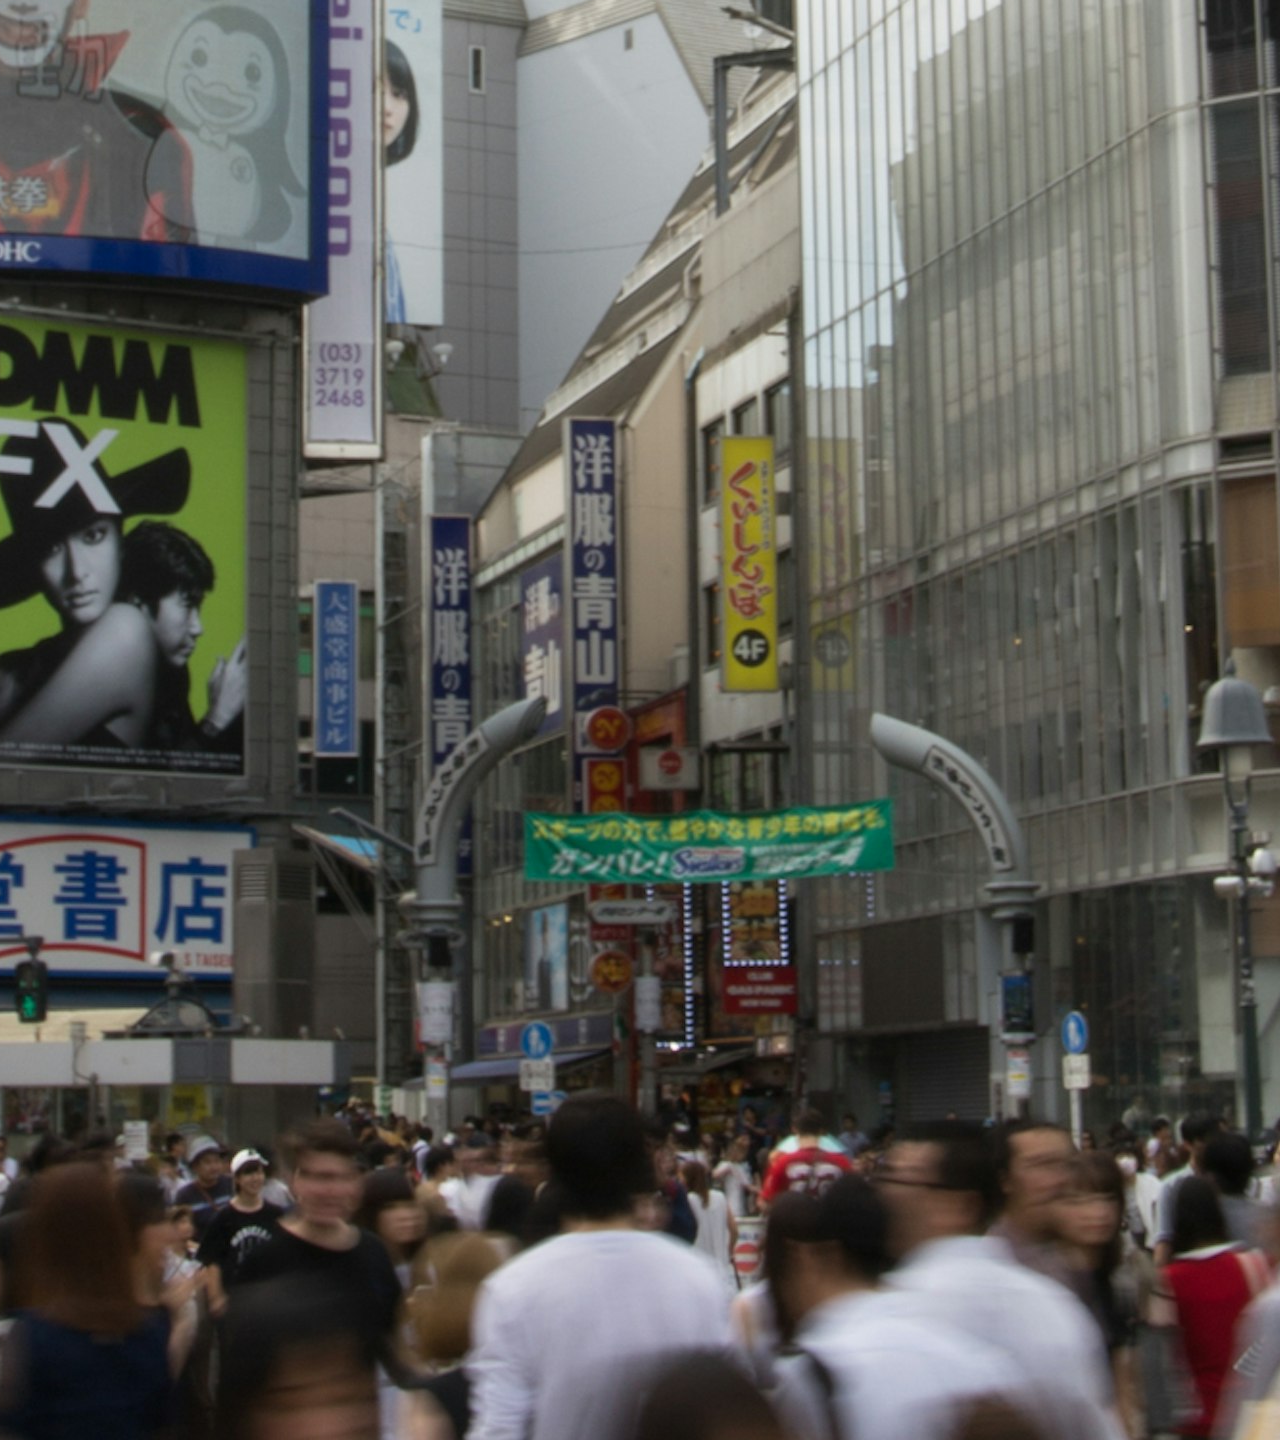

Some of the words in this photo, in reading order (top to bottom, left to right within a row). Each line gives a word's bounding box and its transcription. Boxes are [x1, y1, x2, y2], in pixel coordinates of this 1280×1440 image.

[327, 66, 355, 259] neon
[314, 366, 365, 388] 3719
[315, 387, 366, 409] 2468
[319, 343, 362, 366] (03)
[571, 434, 617, 686] 洋服の青山
[324, 590, 349, 747] 大盛堂商事ビル
[433, 546, 470, 753] 洋服の青
[732, 633, 766, 662] 4F
